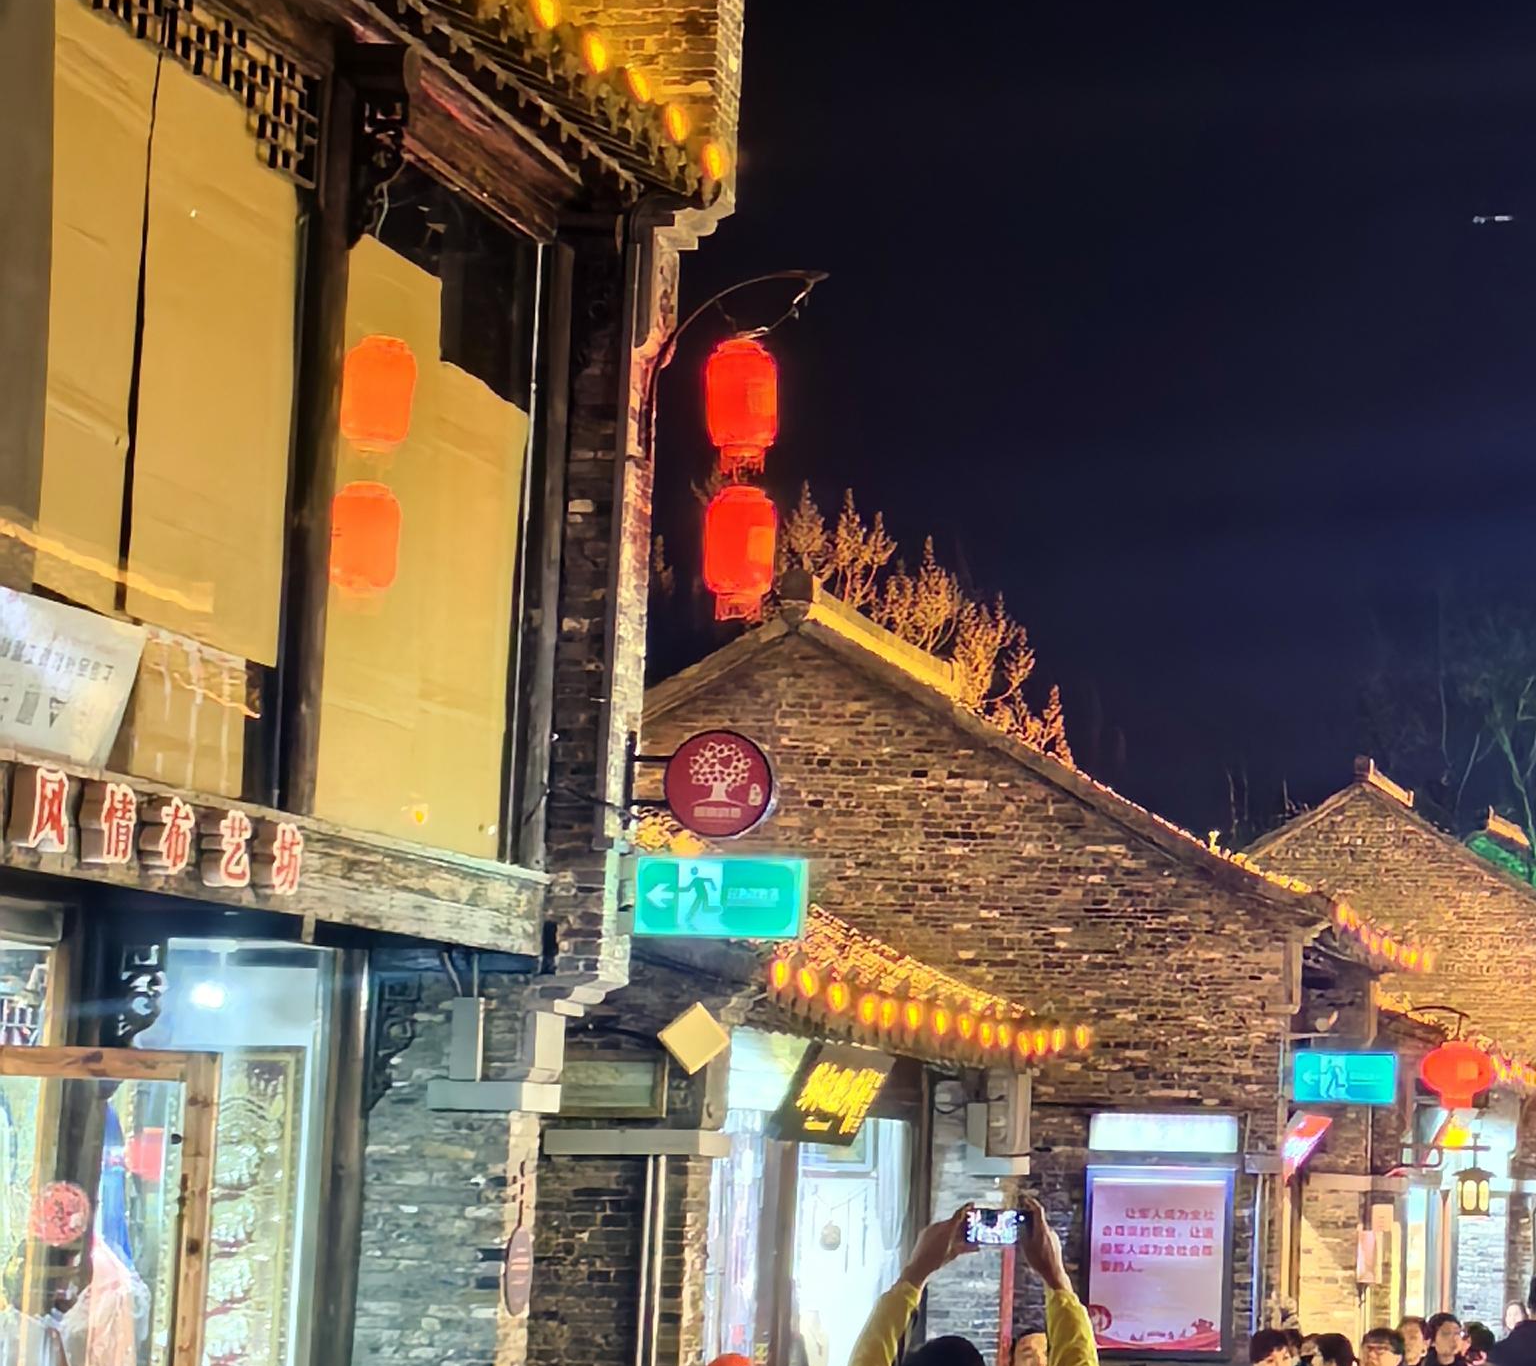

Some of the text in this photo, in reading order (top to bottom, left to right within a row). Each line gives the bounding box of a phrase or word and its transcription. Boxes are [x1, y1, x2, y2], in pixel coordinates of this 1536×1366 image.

[29, 769, 304, 895] 风情布艺坊
